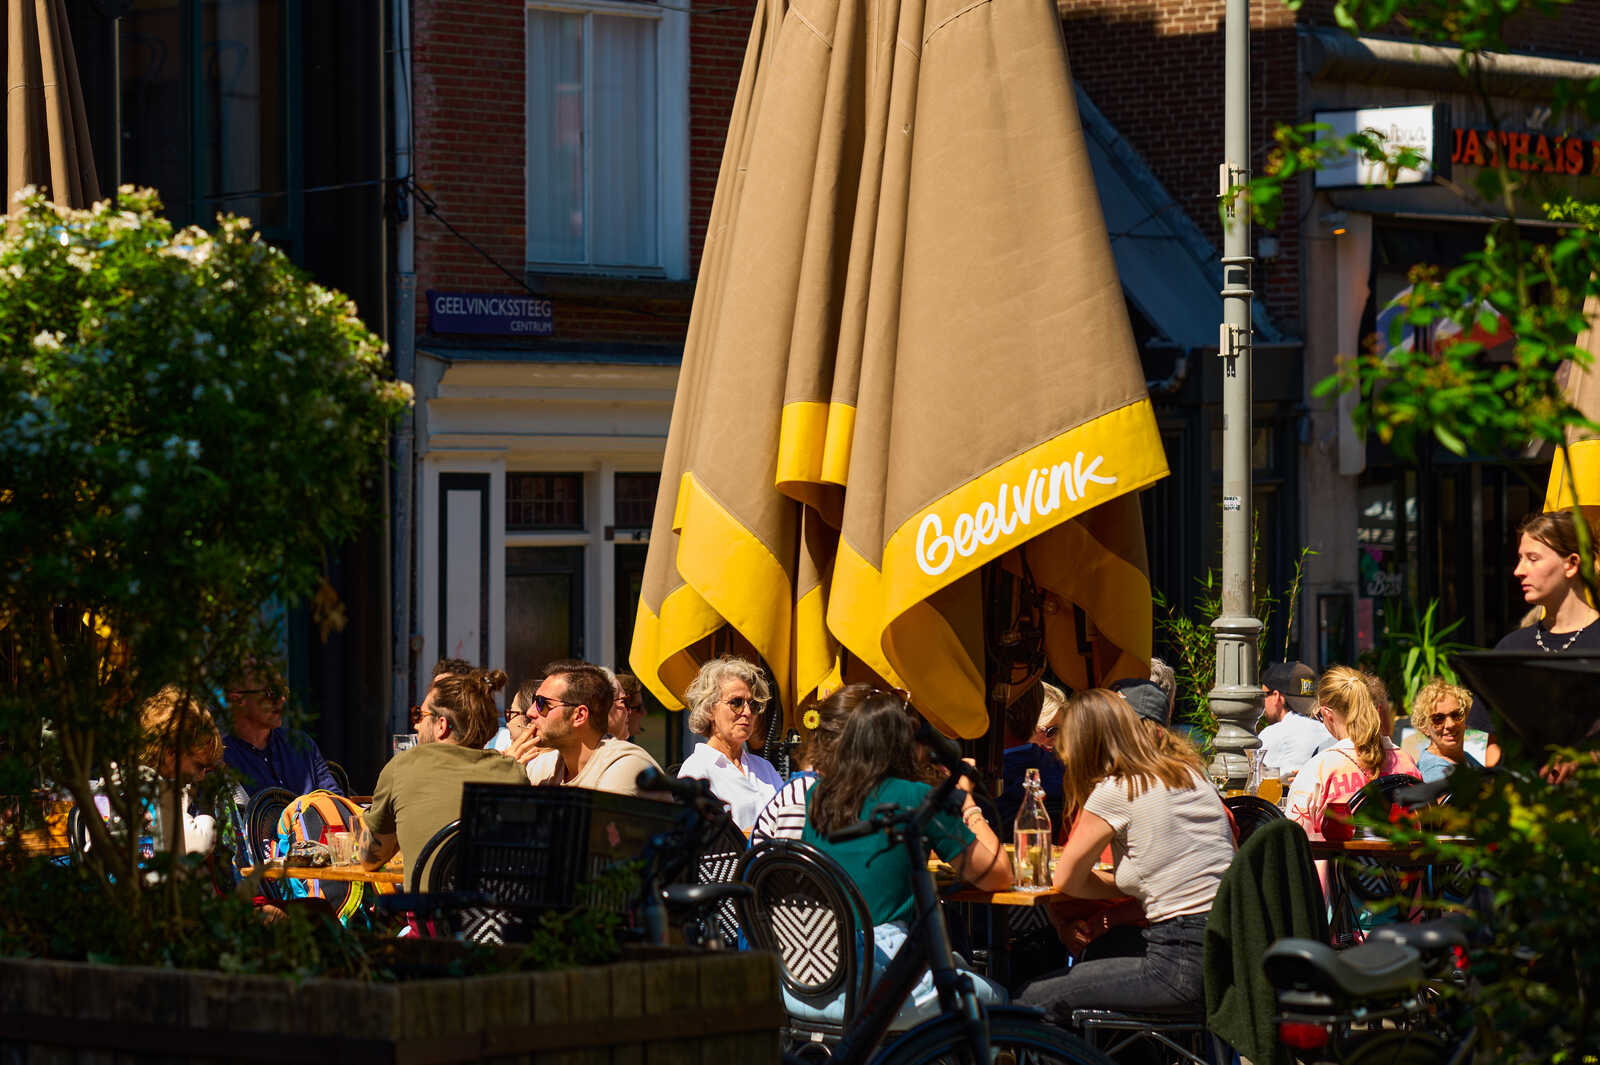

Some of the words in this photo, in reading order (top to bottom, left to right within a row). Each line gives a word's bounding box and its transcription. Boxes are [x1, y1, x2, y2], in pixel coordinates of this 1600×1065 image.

[435, 297, 551, 317] GEELVINCKSSTEEG
[510, 320, 552, 332] CENTRUM
[915, 451, 1118, 575] Geelvink
